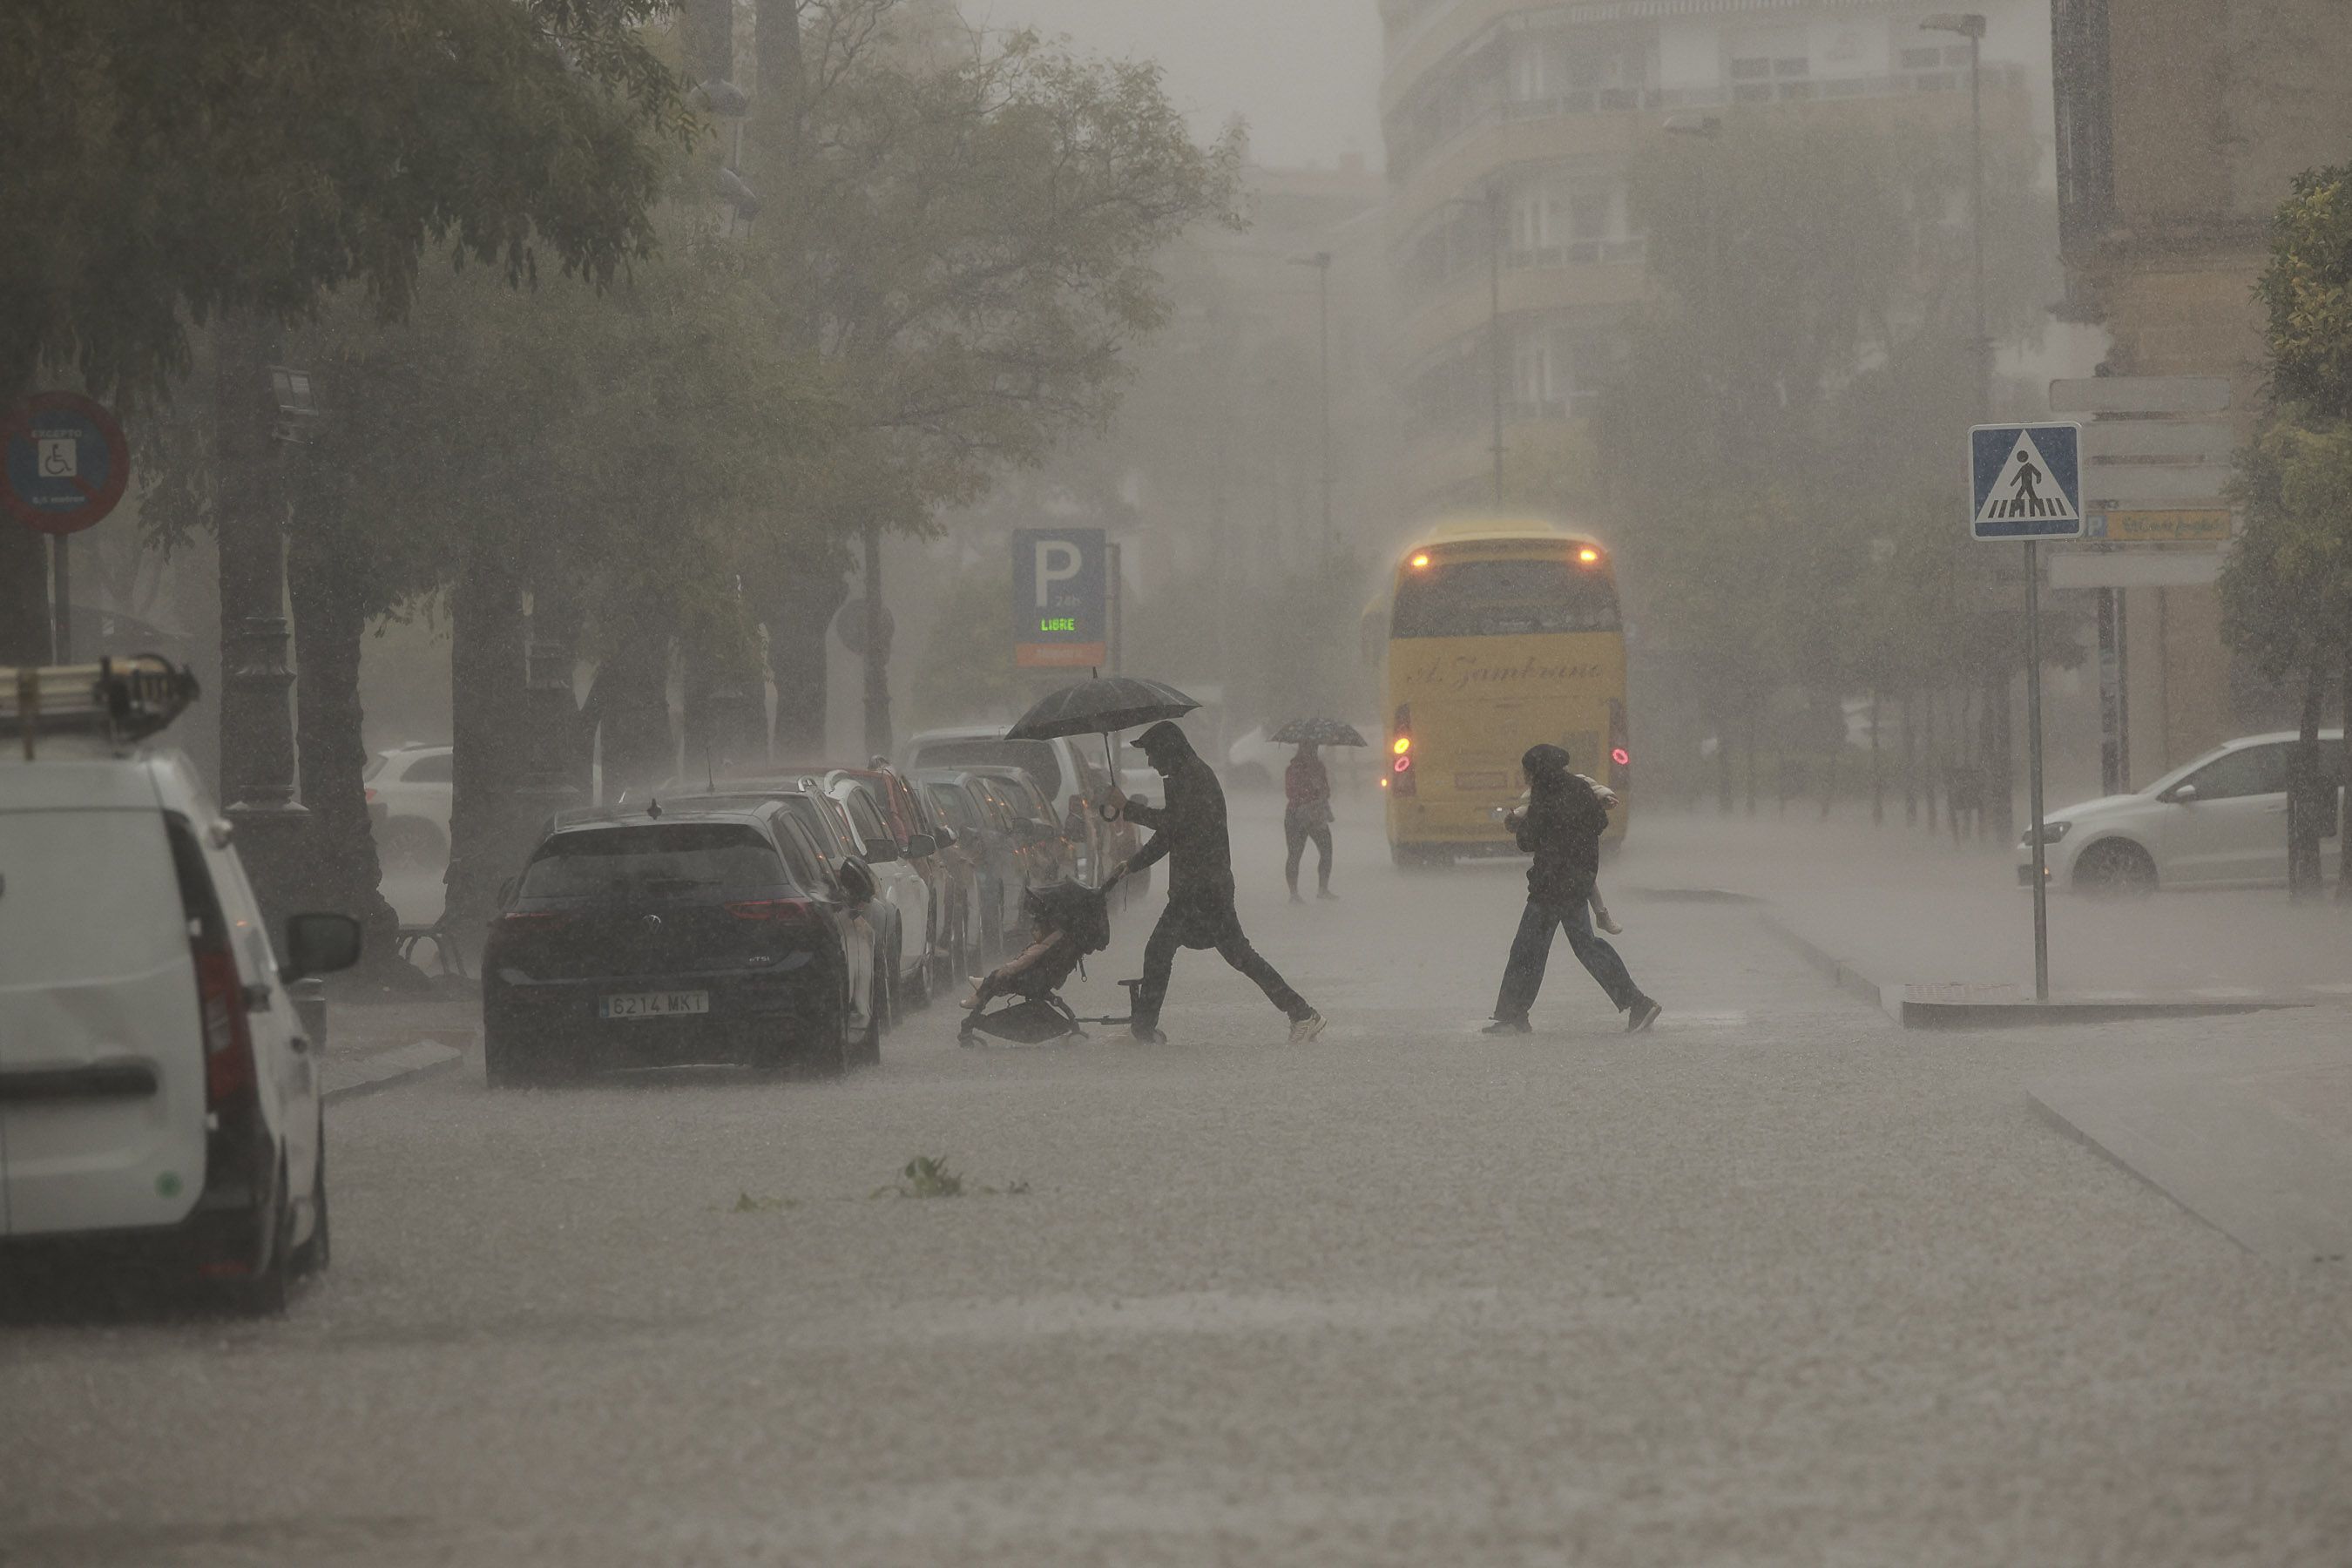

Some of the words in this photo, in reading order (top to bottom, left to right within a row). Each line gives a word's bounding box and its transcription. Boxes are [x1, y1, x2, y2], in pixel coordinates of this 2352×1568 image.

[31, 429, 82, 438] EXCEPTO
[2087, 517, 2103, 536] P
[1036, 540, 1082, 607] P
[1040, 618, 1076, 632] LIBRE
[614, 997, 661, 1015] 6214
[668, 994, 704, 1011] MKT
